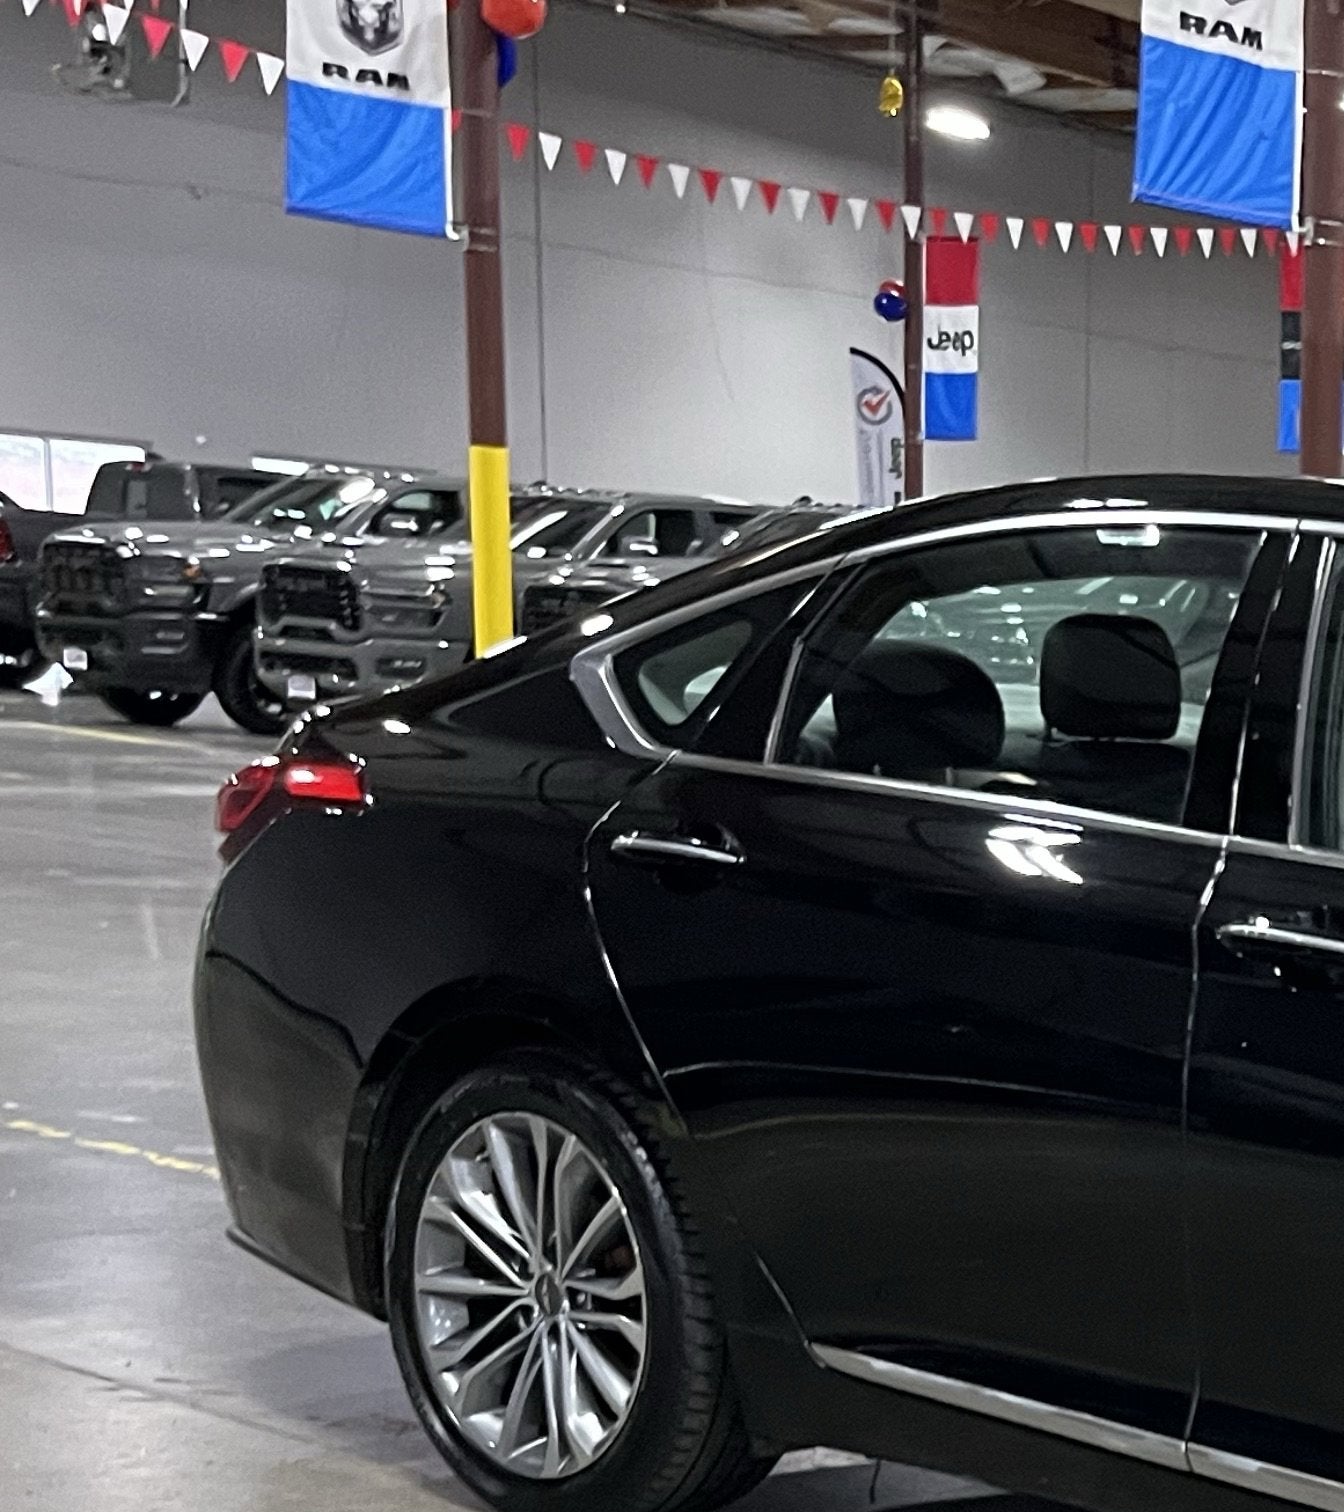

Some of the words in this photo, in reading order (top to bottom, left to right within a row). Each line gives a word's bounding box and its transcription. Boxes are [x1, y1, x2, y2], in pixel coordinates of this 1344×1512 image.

[1179, 11, 1263, 51] RAM
[322, 62, 410, 91] RAM
[926, 324, 974, 357] Jeep
